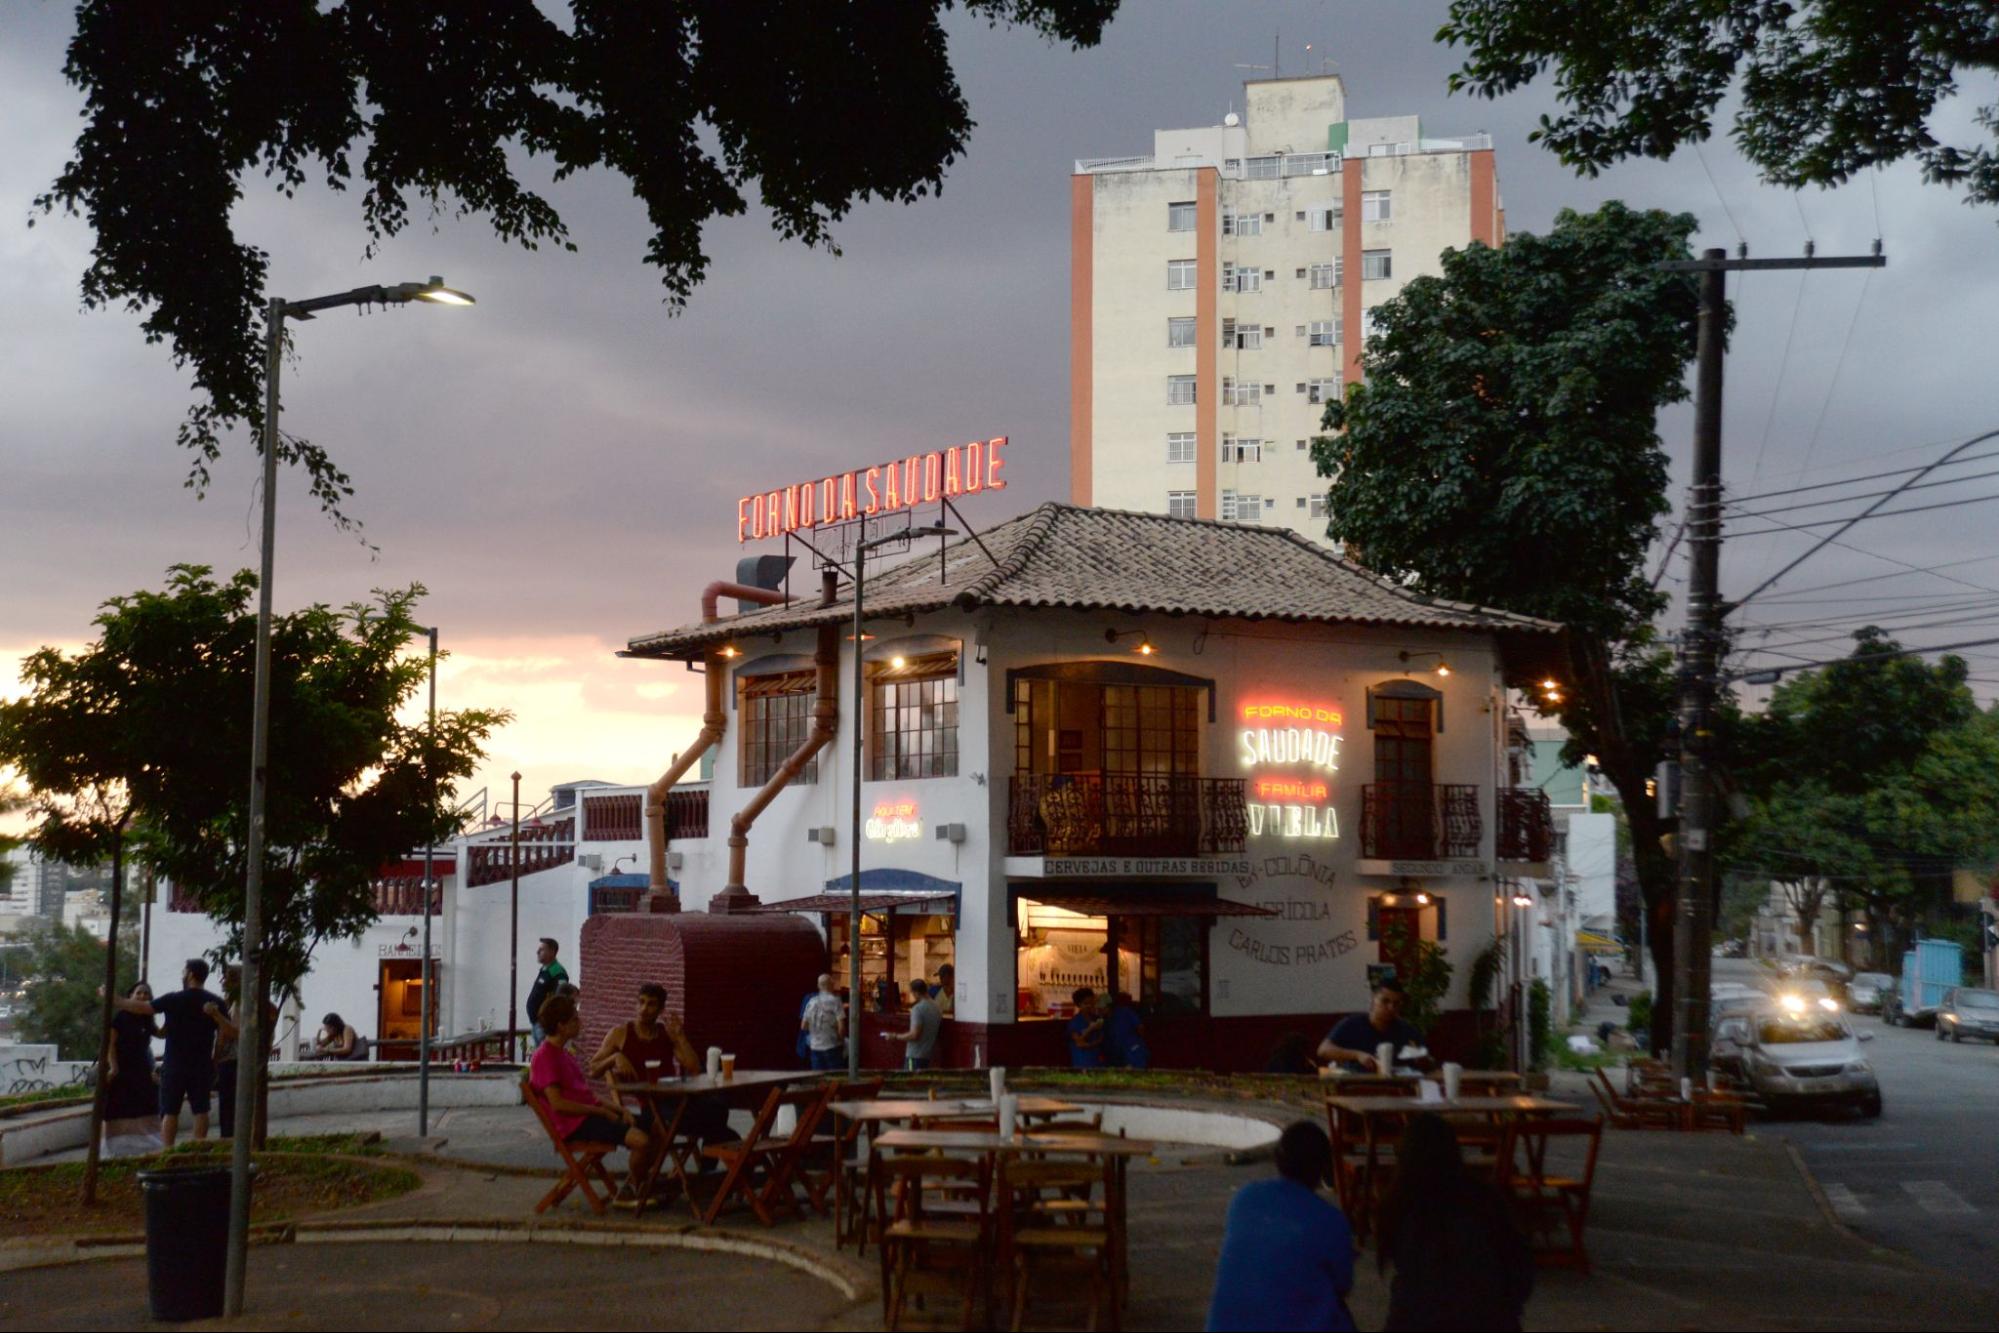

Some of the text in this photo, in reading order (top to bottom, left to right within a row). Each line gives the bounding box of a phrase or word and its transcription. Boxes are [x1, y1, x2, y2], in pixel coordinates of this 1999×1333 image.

[738, 437, 1008, 544] FORNO DA SAUDADE
[1244, 705, 1343, 726] FORNO DA
[1242, 728, 1344, 770] SAUDADE
[1260, 781, 1327, 798] FAMÍLIA
[1248, 804, 1340, 838] VIELA
[1044, 861, 1249, 874] CERVEJAS E OUTRAS BEBIDAS
[1228, 928, 1358, 965] CARLOS PRATES
